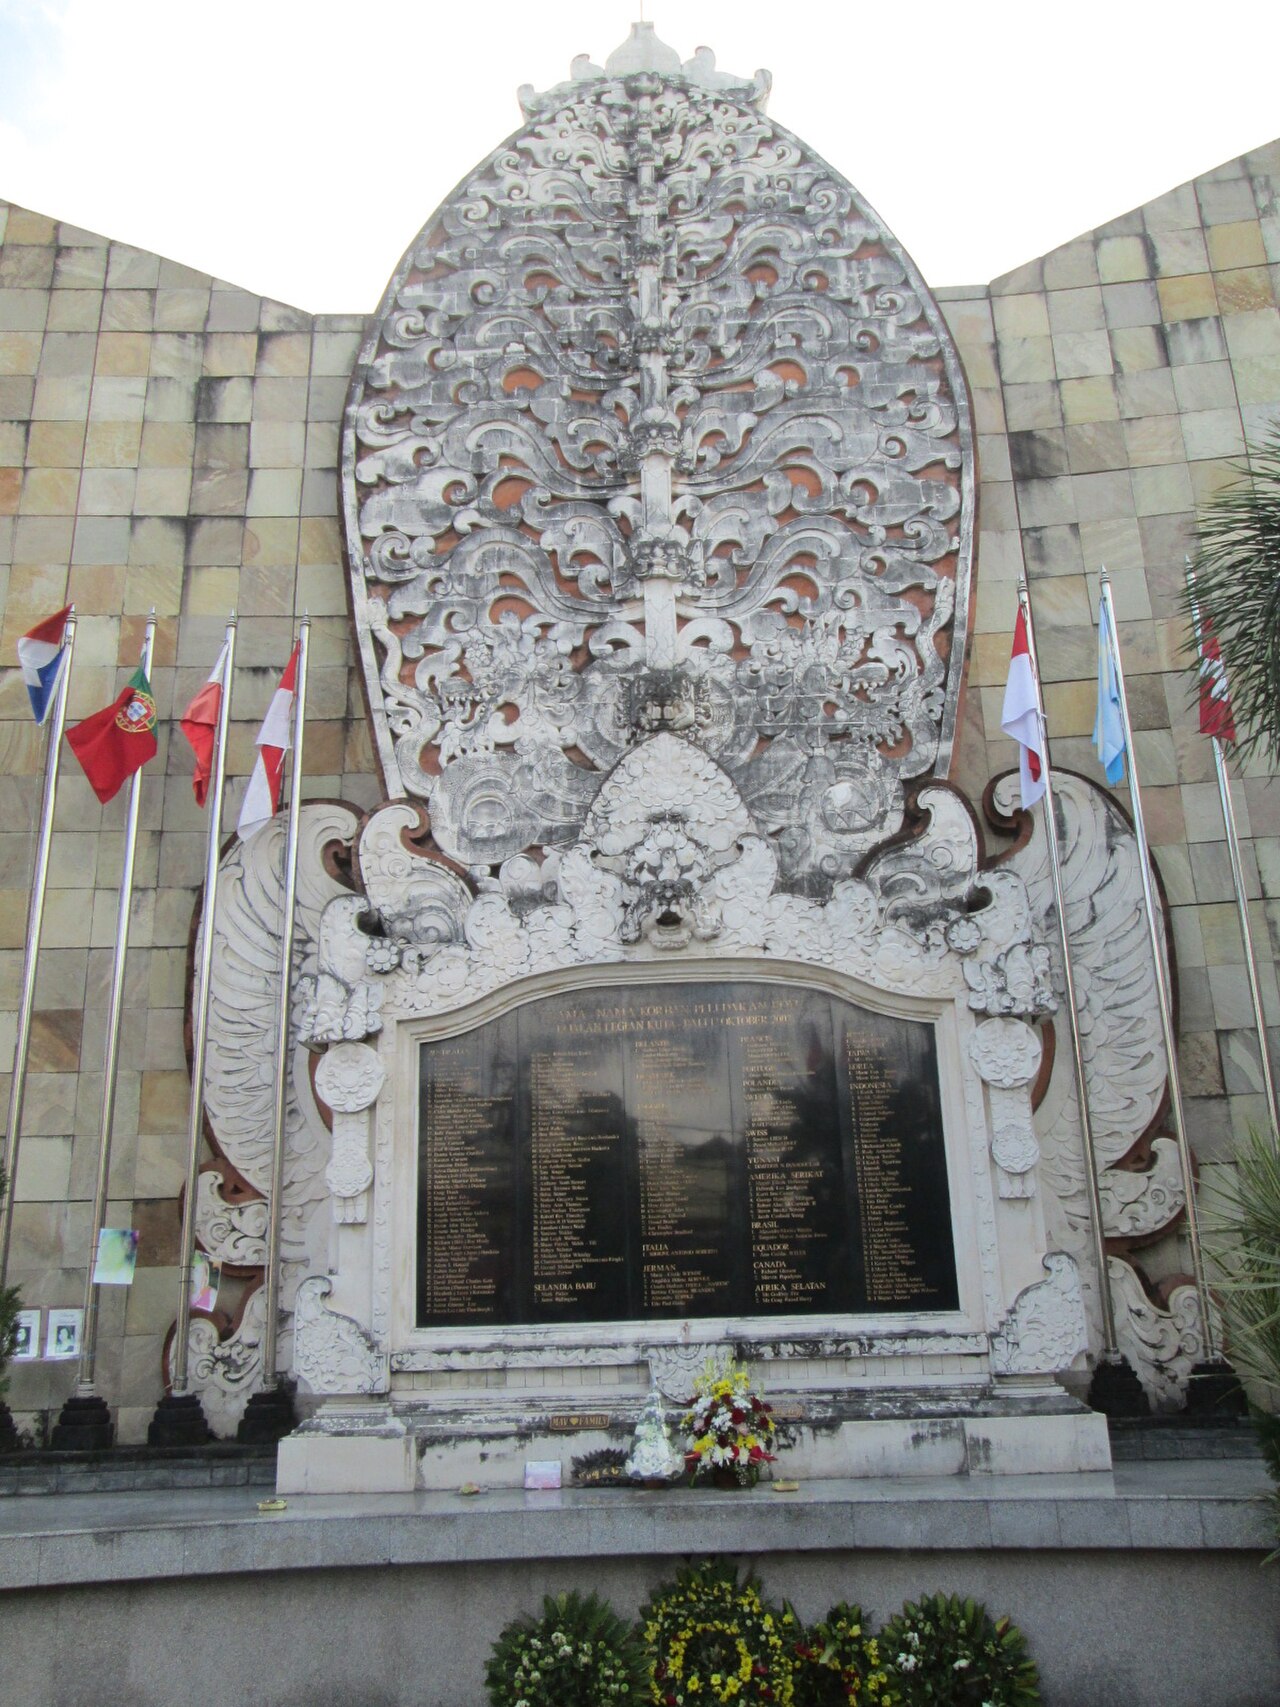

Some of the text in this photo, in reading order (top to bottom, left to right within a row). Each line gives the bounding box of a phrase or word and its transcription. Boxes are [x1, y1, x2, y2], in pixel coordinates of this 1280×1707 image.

[596, 1008, 635, 1018] NAMA
[604, 1020, 645, 1033] LEGIAN
[647, 1019, 677, 1031] KUTA
[720, 1014, 768, 1027] OKTOBER
[849, 1081, 892, 1090] INDONESIA
[745, 1129, 768, 1137] SWISS
[747, 1156, 780, 1164] YUNANI
[751, 1220, 778, 1229] BRASIL
[642, 1243, 669, 1252] ITALIA
[752, 1243, 790, 1252] EQUADOR
[643, 1263, 676, 1273] JERMAN
[753, 1260, 787, 1269] CANADA
[533, 1281, 597, 1291] SELANDIA BARU
[755, 1281, 826, 1292] AFRIKA SELATAN
[579, 1415, 608, 1426] FAMILY
